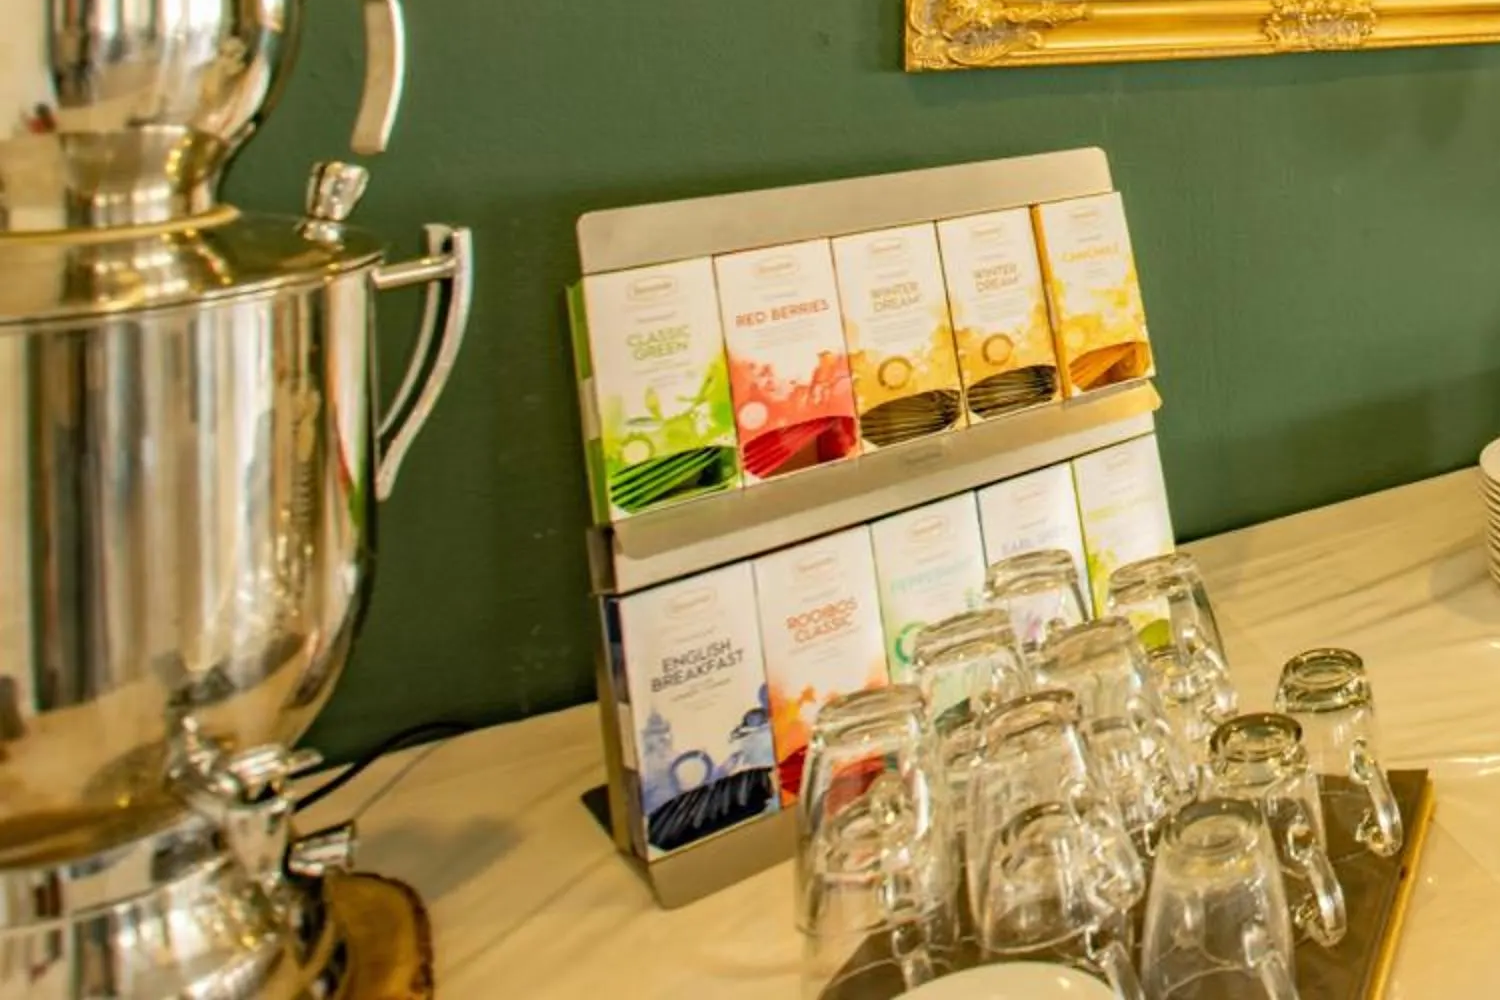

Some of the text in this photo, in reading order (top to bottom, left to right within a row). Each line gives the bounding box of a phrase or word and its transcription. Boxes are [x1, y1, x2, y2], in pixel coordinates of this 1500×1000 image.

[735, 298, 831, 329] RED BERRIES
[625, 323, 691, 348] CLASSIC
[632, 340, 689, 362] GREEN
[785, 596, 859, 630] ROOIBOS
[793, 612, 854, 644] CLASSIC
[649, 646, 745, 694] BREAKFAST
[661, 636, 732, 674] ENGLISH
